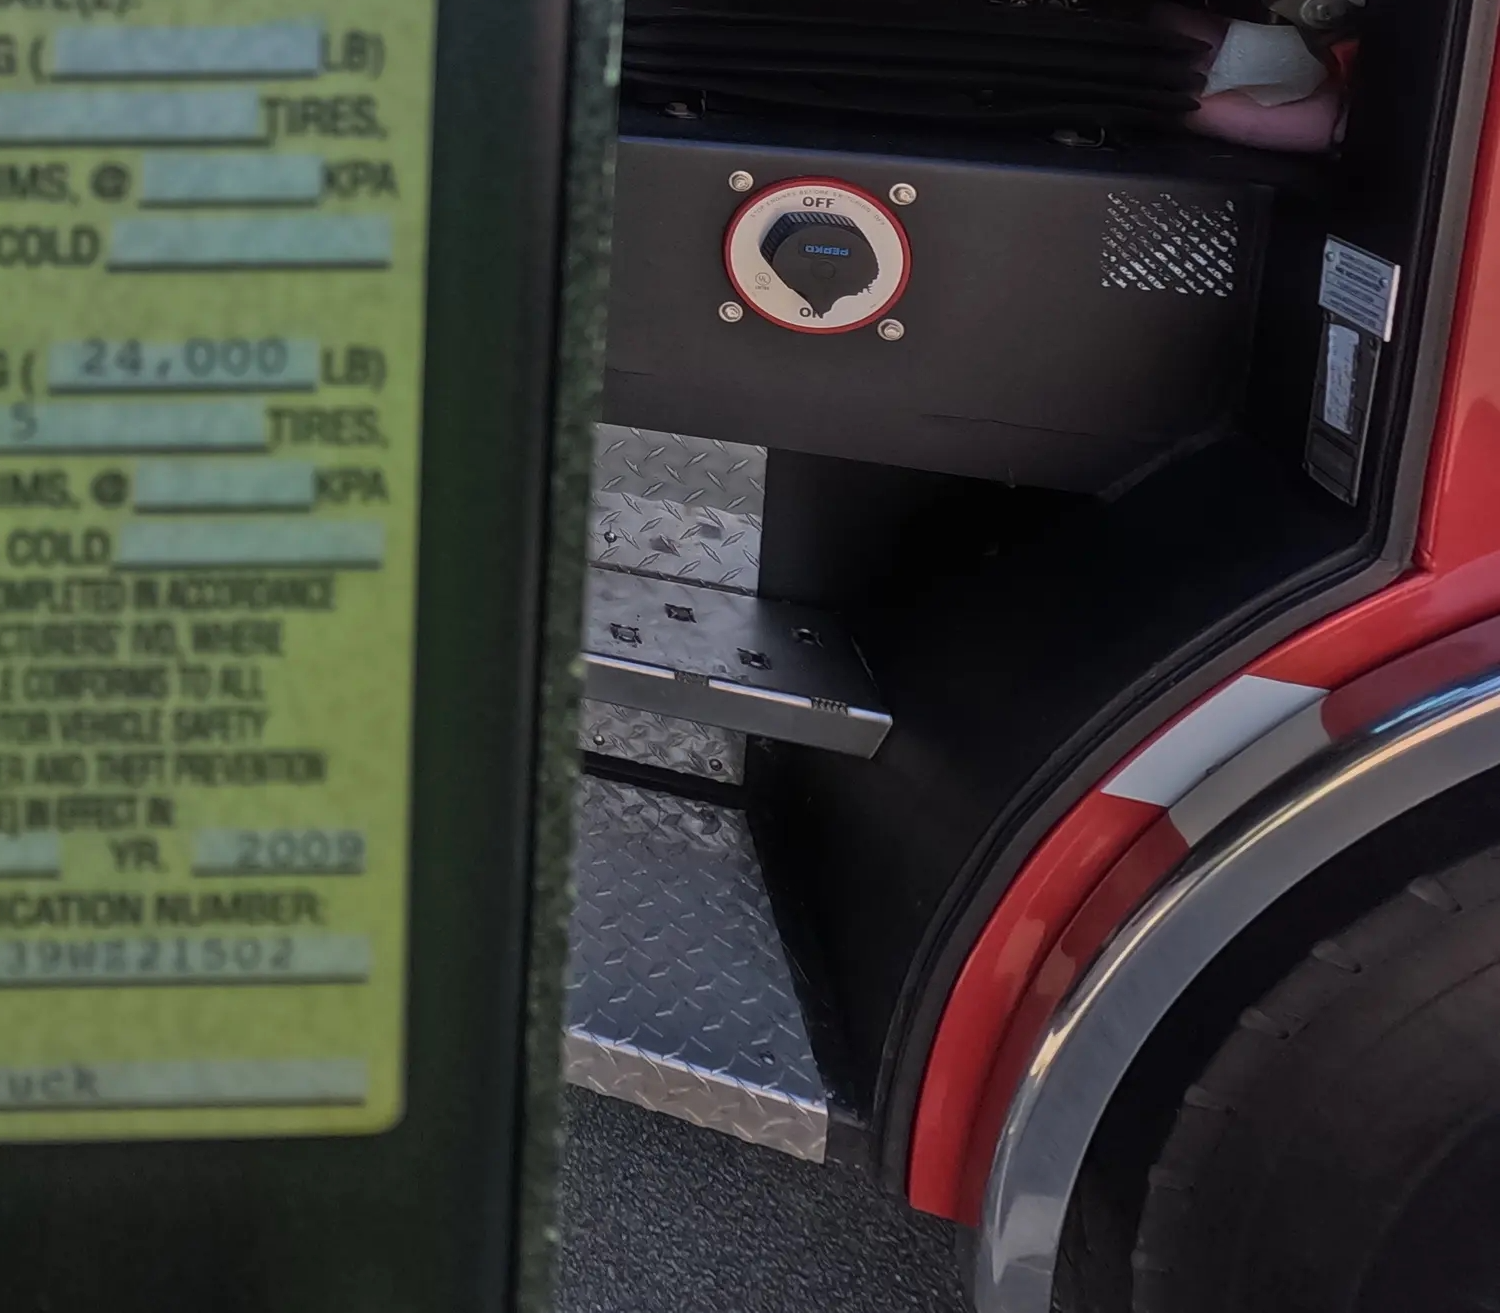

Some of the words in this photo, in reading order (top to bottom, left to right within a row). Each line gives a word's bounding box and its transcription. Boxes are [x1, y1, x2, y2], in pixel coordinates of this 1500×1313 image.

[320, 158, 400, 200] KPA
[802, 196, 836, 209] OFF
[80, 335, 289, 378] 24,000
[312, 466, 391, 506] KPA
[6, 527, 111, 566] COLD
[237, 829, 366, 869] 2009
